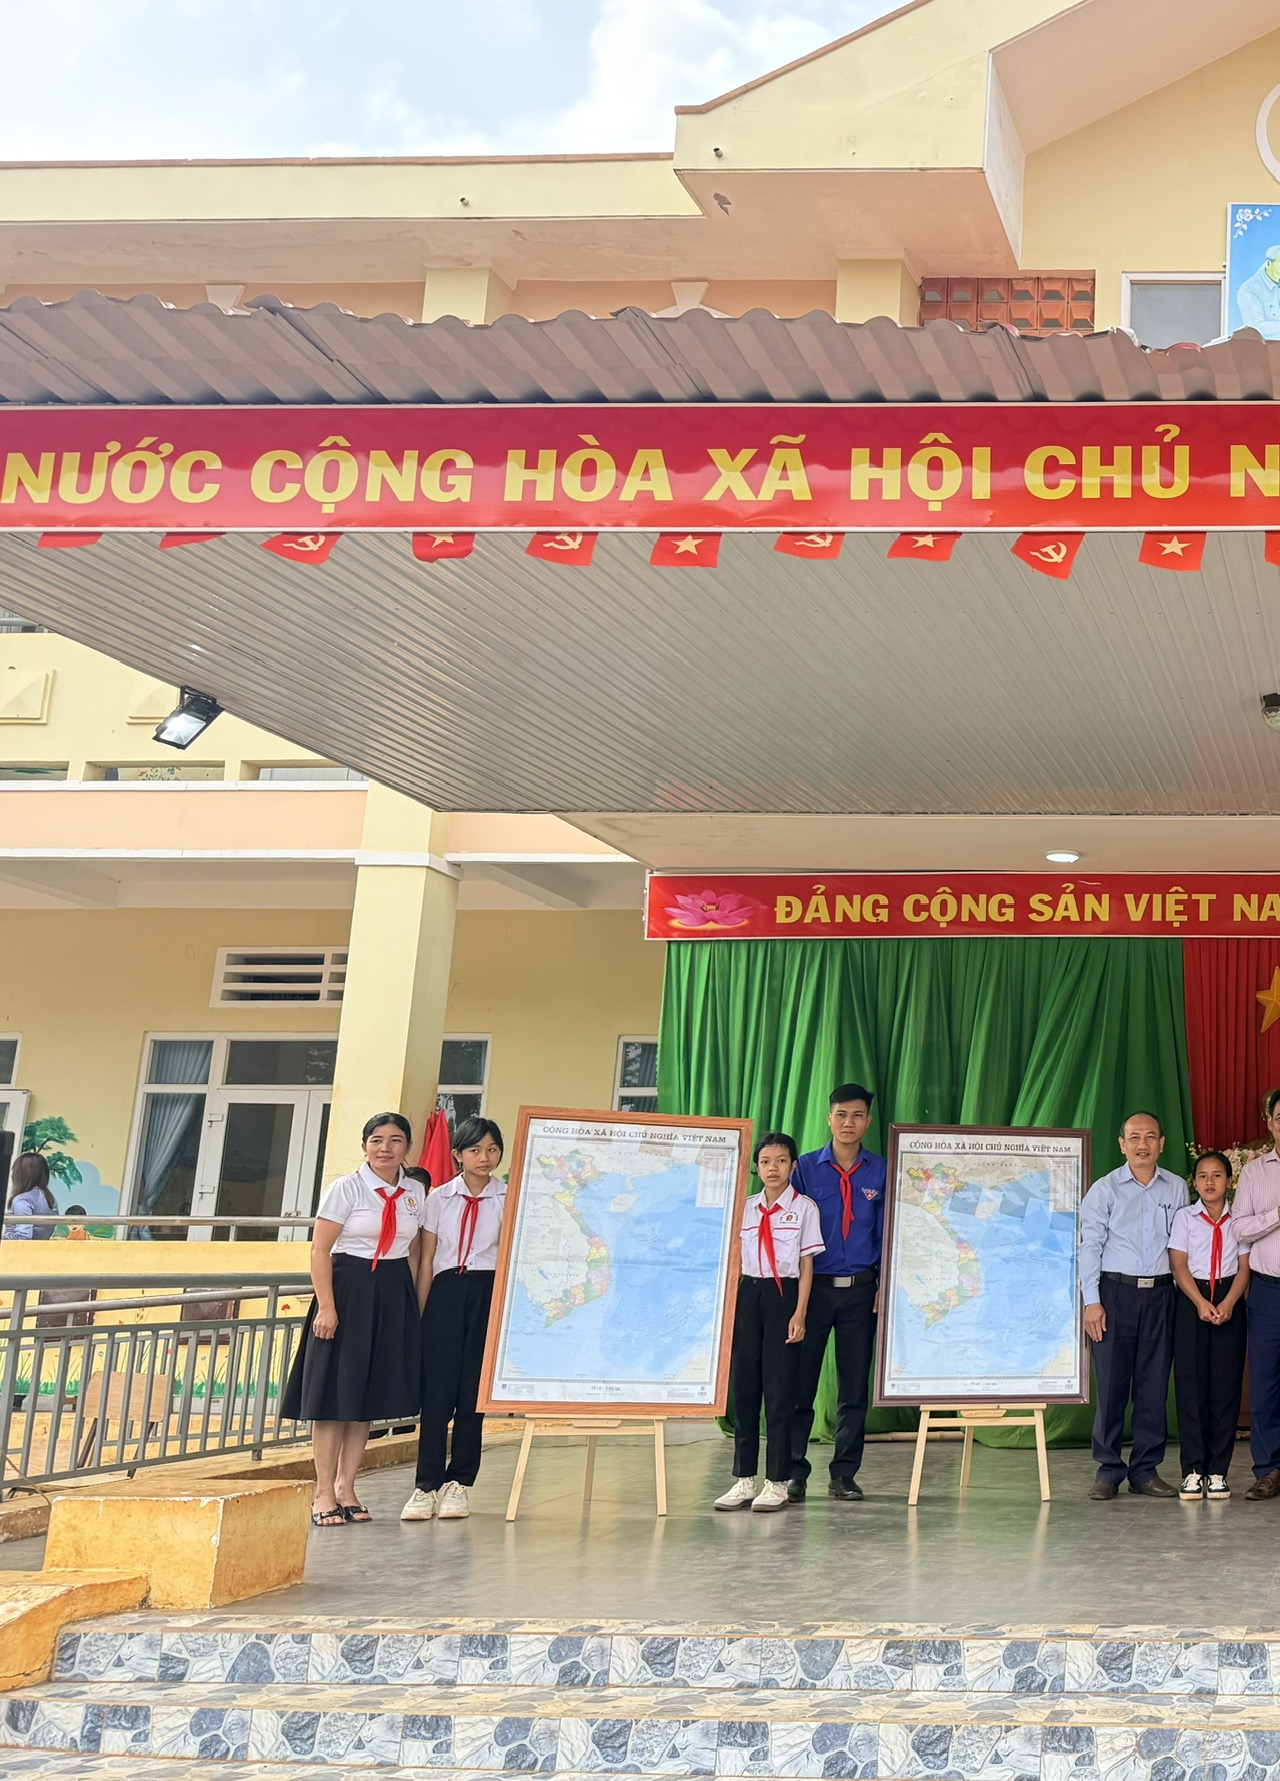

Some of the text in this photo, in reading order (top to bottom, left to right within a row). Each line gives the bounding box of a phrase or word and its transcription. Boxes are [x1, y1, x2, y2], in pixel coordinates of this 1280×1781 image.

[2, 437, 221, 504] NƯỚC
[251, 436, 473, 513] CỘNG
[504, 434, 674, 502] HÒA
[704, 434, 813, 502] XÃ
[850, 432, 990, 511] HỘI
[1024, 424, 1190, 500] CHỦ
[775, 885, 889, 923] ĐẢNG
[903, 887, 1015, 928] CỘNG
[1028, 883, 1110, 922] SẢN
[1125, 886, 1217, 927] VIỆT
